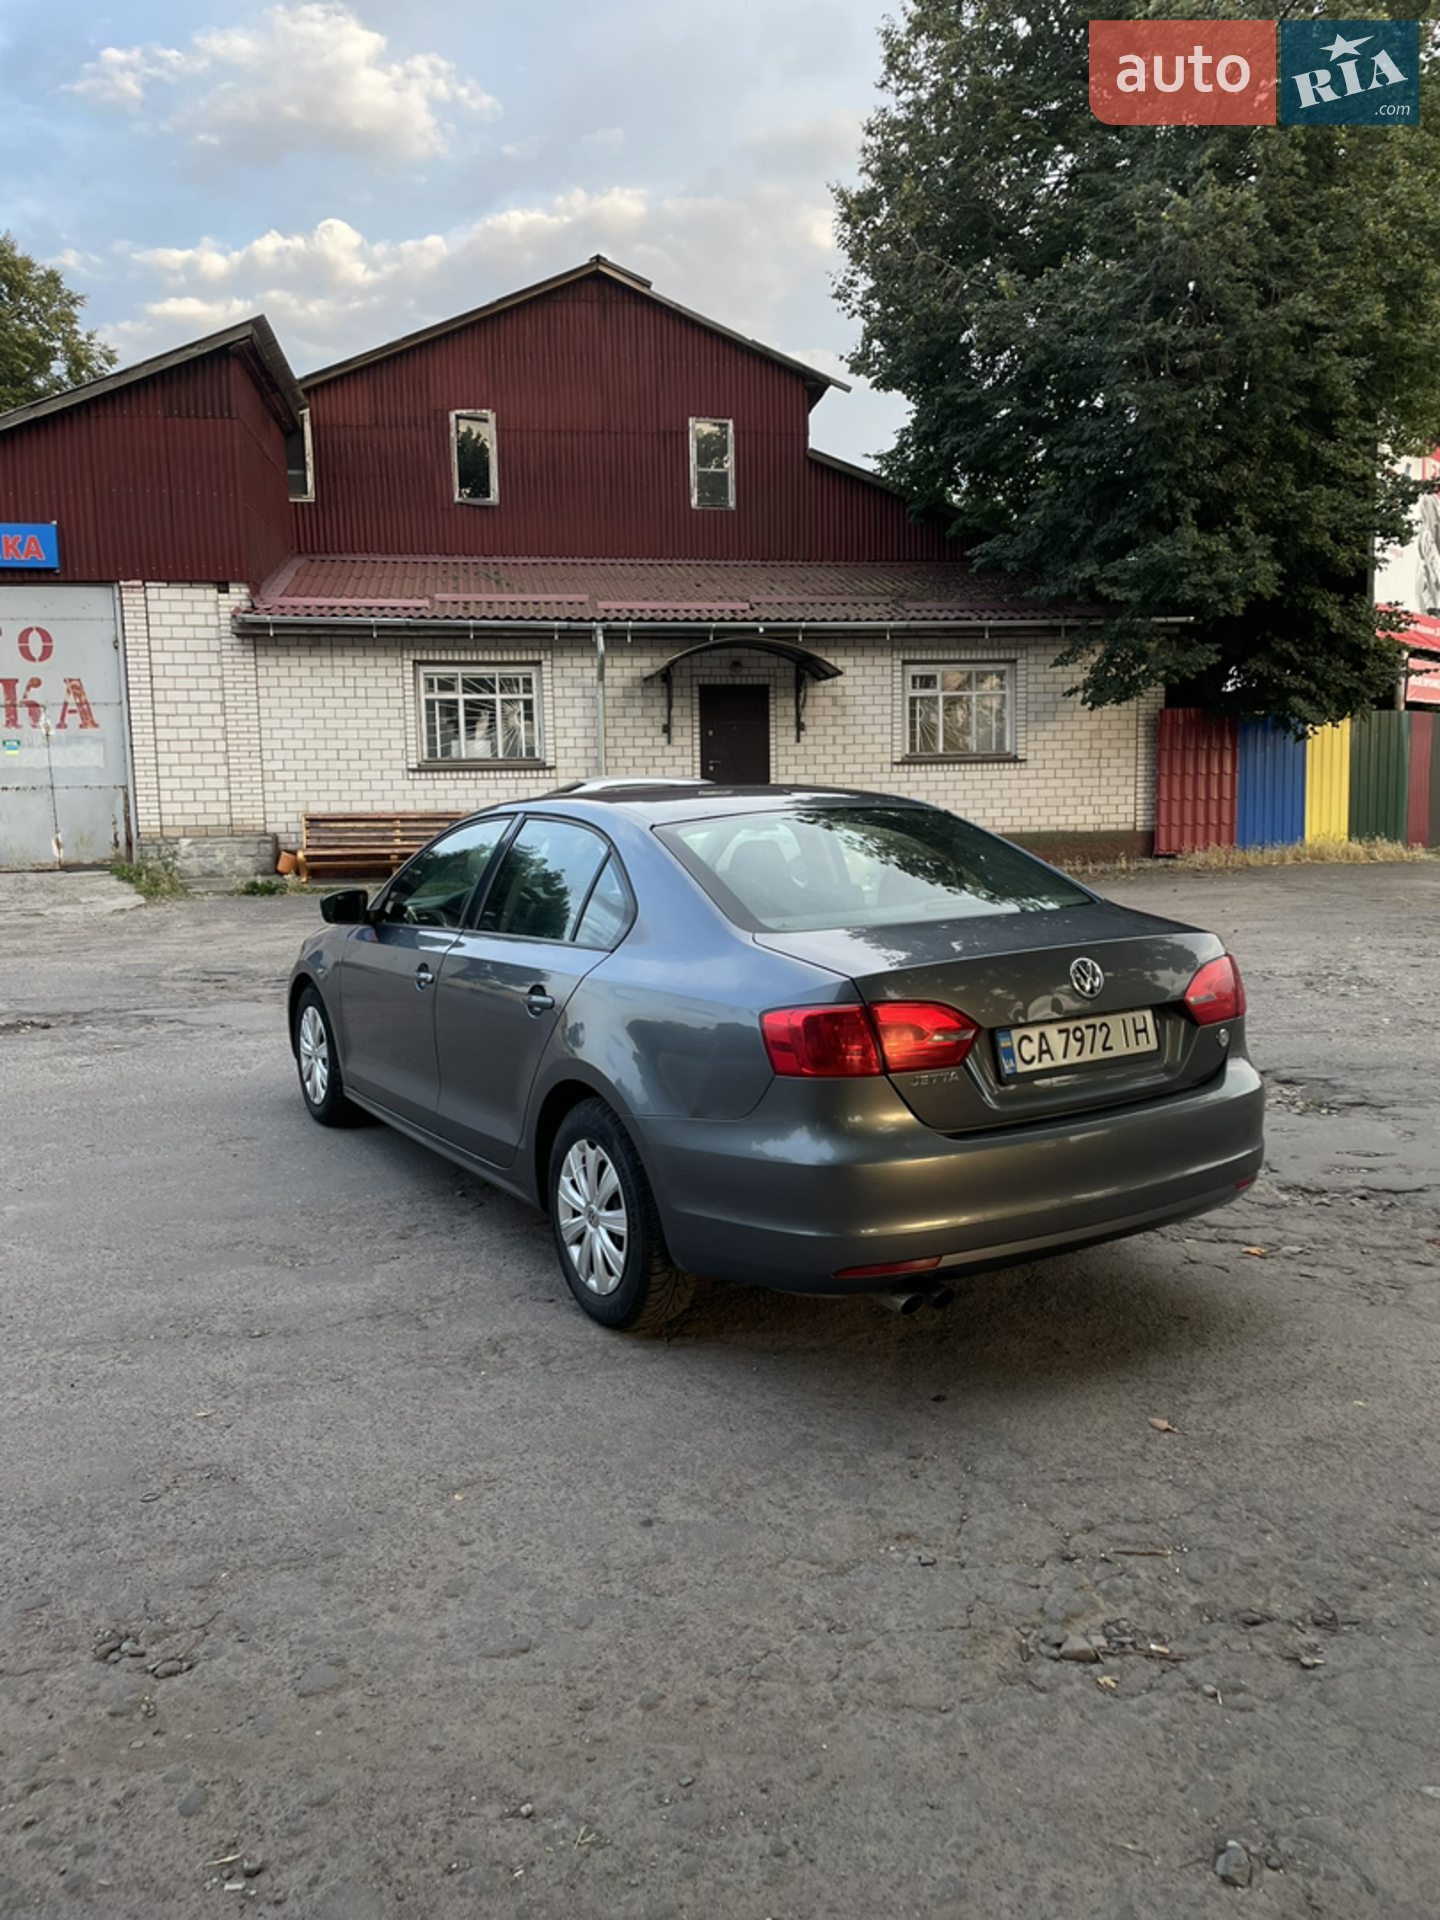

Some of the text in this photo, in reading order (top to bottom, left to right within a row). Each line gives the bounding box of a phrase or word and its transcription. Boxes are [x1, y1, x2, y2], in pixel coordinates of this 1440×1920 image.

[1018, 1015, 1150, 1065] CA 7972 IH
[910, 1071, 959, 1087] JETTA
